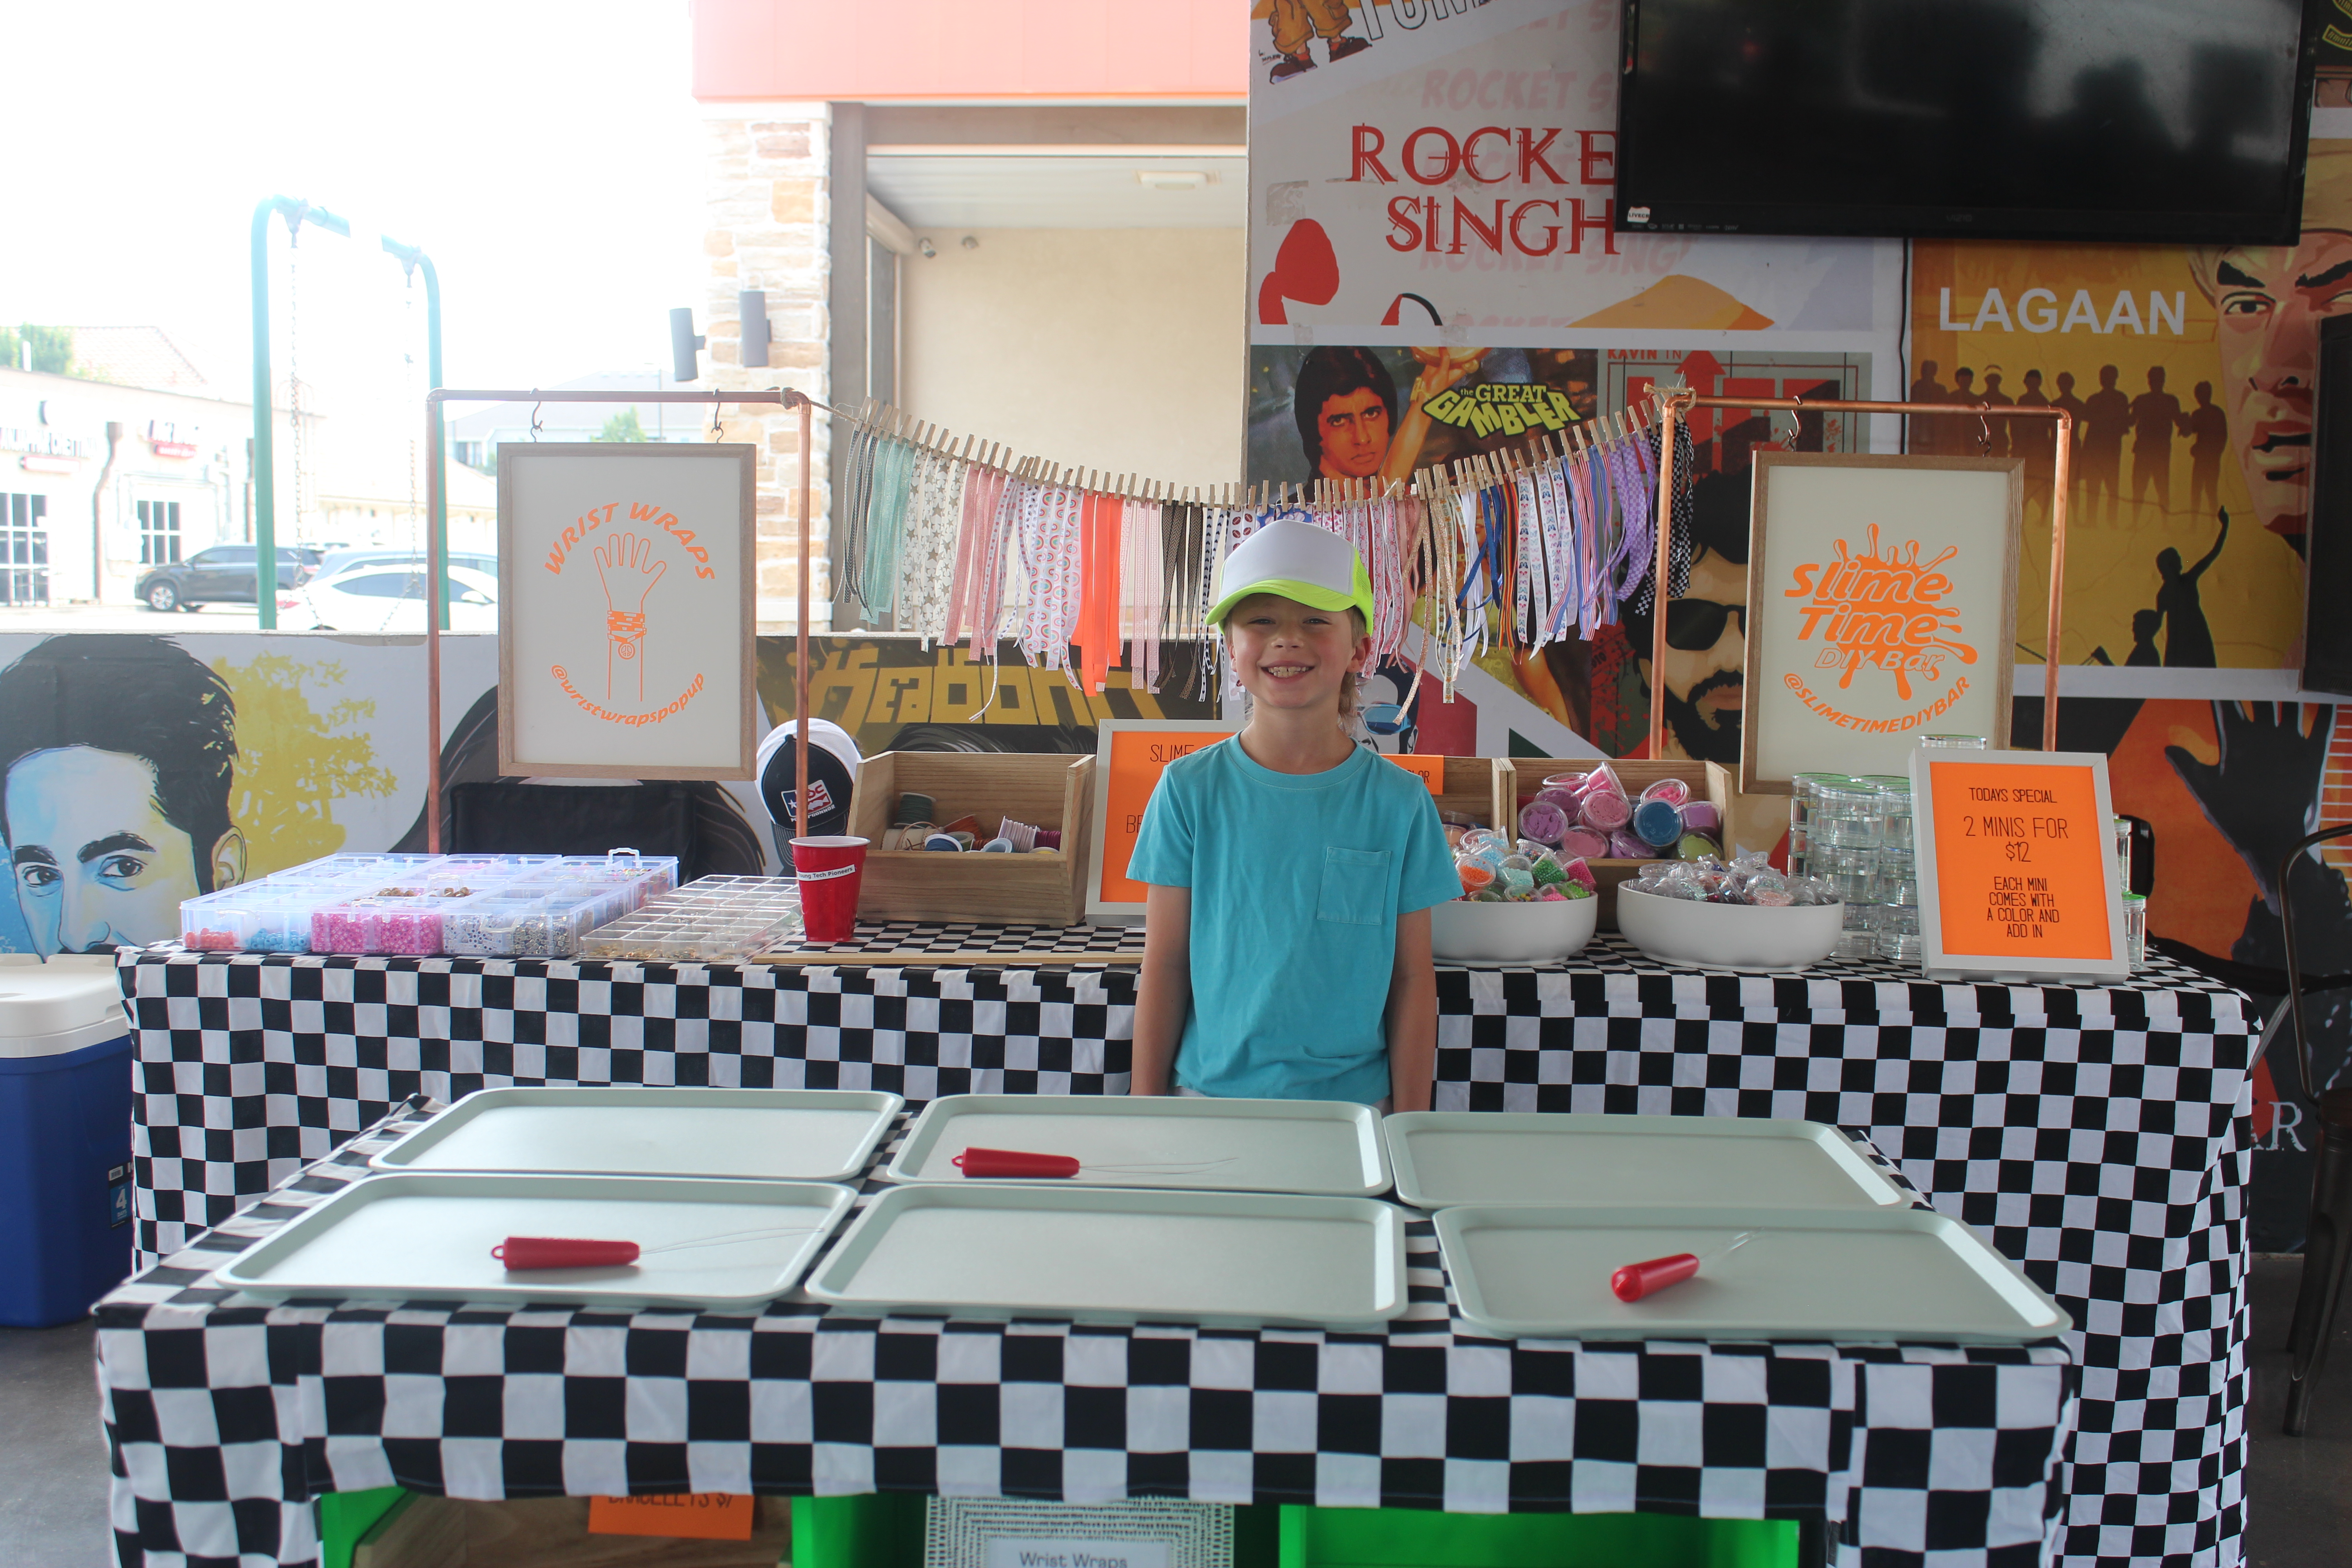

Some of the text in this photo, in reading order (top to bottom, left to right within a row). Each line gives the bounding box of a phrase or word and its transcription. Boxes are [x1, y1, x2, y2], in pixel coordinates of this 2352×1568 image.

[1421, 68, 1578, 111] ROCKET
[1386, 194, 1621, 256] SINGH
[1940, 287, 2185, 335] LAGAAN
[1475, 384, 1546, 402] GREAT
[1424, 390, 1581, 438] GAMBLER
[544, 502, 715, 579] WRIST WRAPS
[1784, 559, 1949, 604] Slime
[1798, 603, 1939, 645] Time
[1815, 648, 1945, 672] DIY Bar
[551, 665, 704, 727] @wristwrapspopup
[1784, 673, 1970, 734] @SLIMETIMEDIYBAR
[1969, 788, 2057, 803] TODAYS SPECIAL
[1963, 816, 2068, 838] 2 MINIS FOR
[2005, 841, 2031, 862] $12
[828, 867, 853, 877] Pioneers
[1994, 877, 2048, 891] EACH MINI
[1989, 892, 2054, 907] COMES WITH
[1987, 908, 2059, 923] A COLOR AND
[2007, 924, 2043, 938] ADD IN
[116, 1188, 127, 1210] 4
[1019, 1552, 1127, 1568] Wrist Wraps
